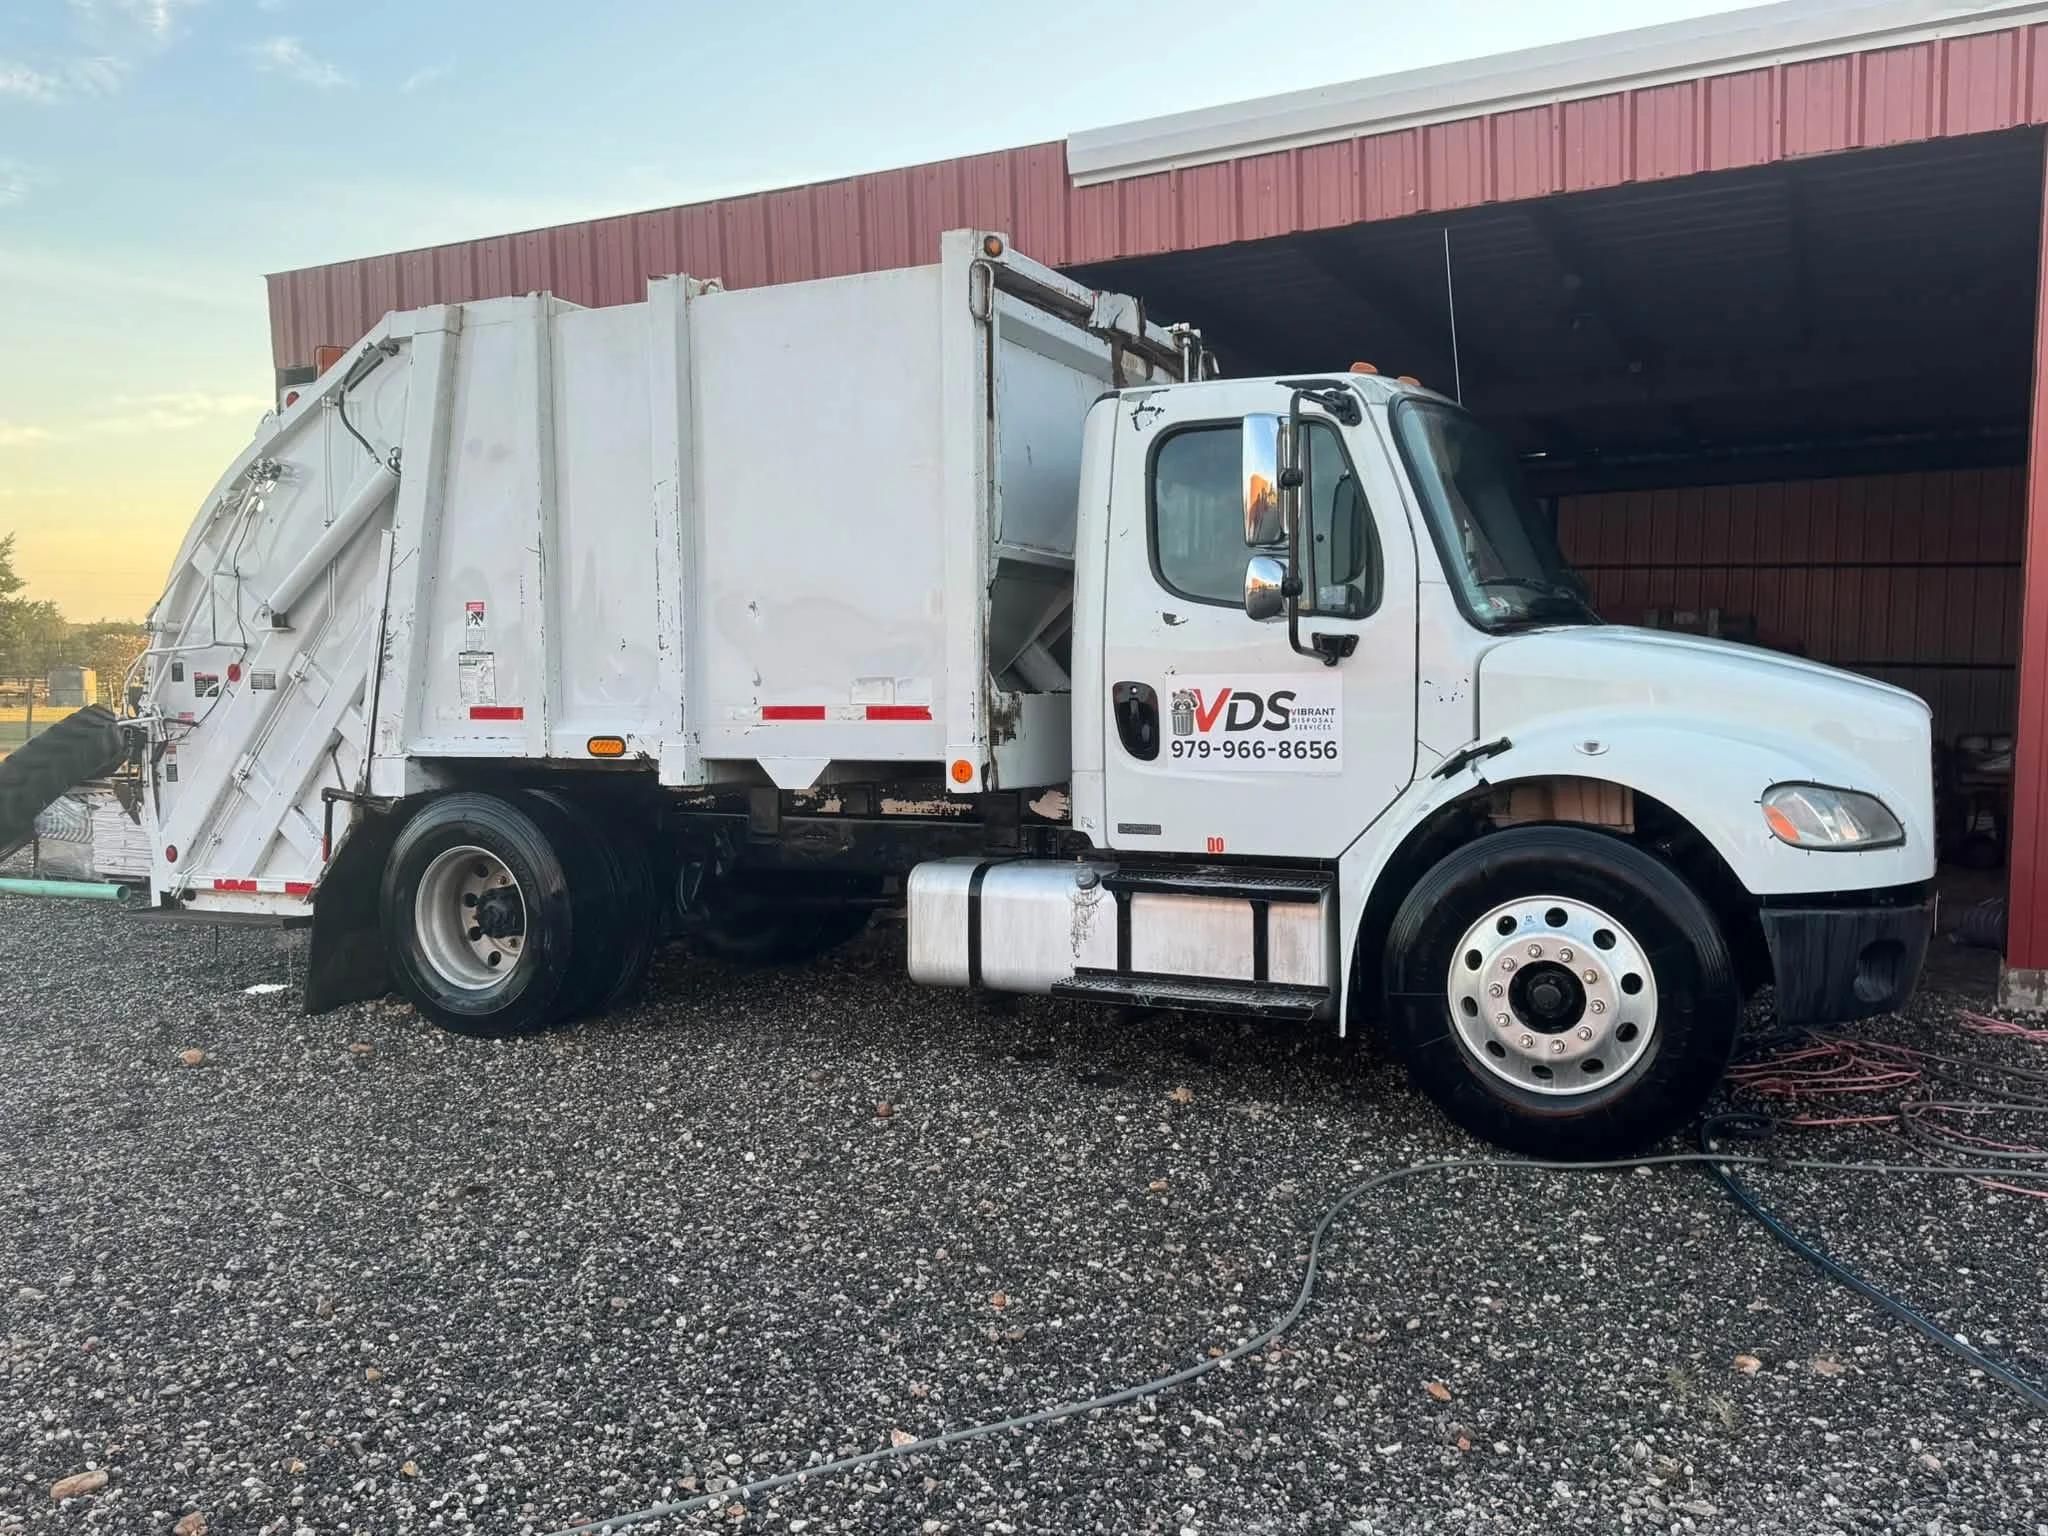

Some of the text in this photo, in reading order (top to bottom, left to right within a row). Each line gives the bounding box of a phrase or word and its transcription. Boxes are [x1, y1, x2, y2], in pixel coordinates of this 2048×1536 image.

[1192, 688, 1296, 732] VDS
[1290, 708, 1336, 716] VIBRANT
[1171, 740, 1338, 759] 979-966-8656
